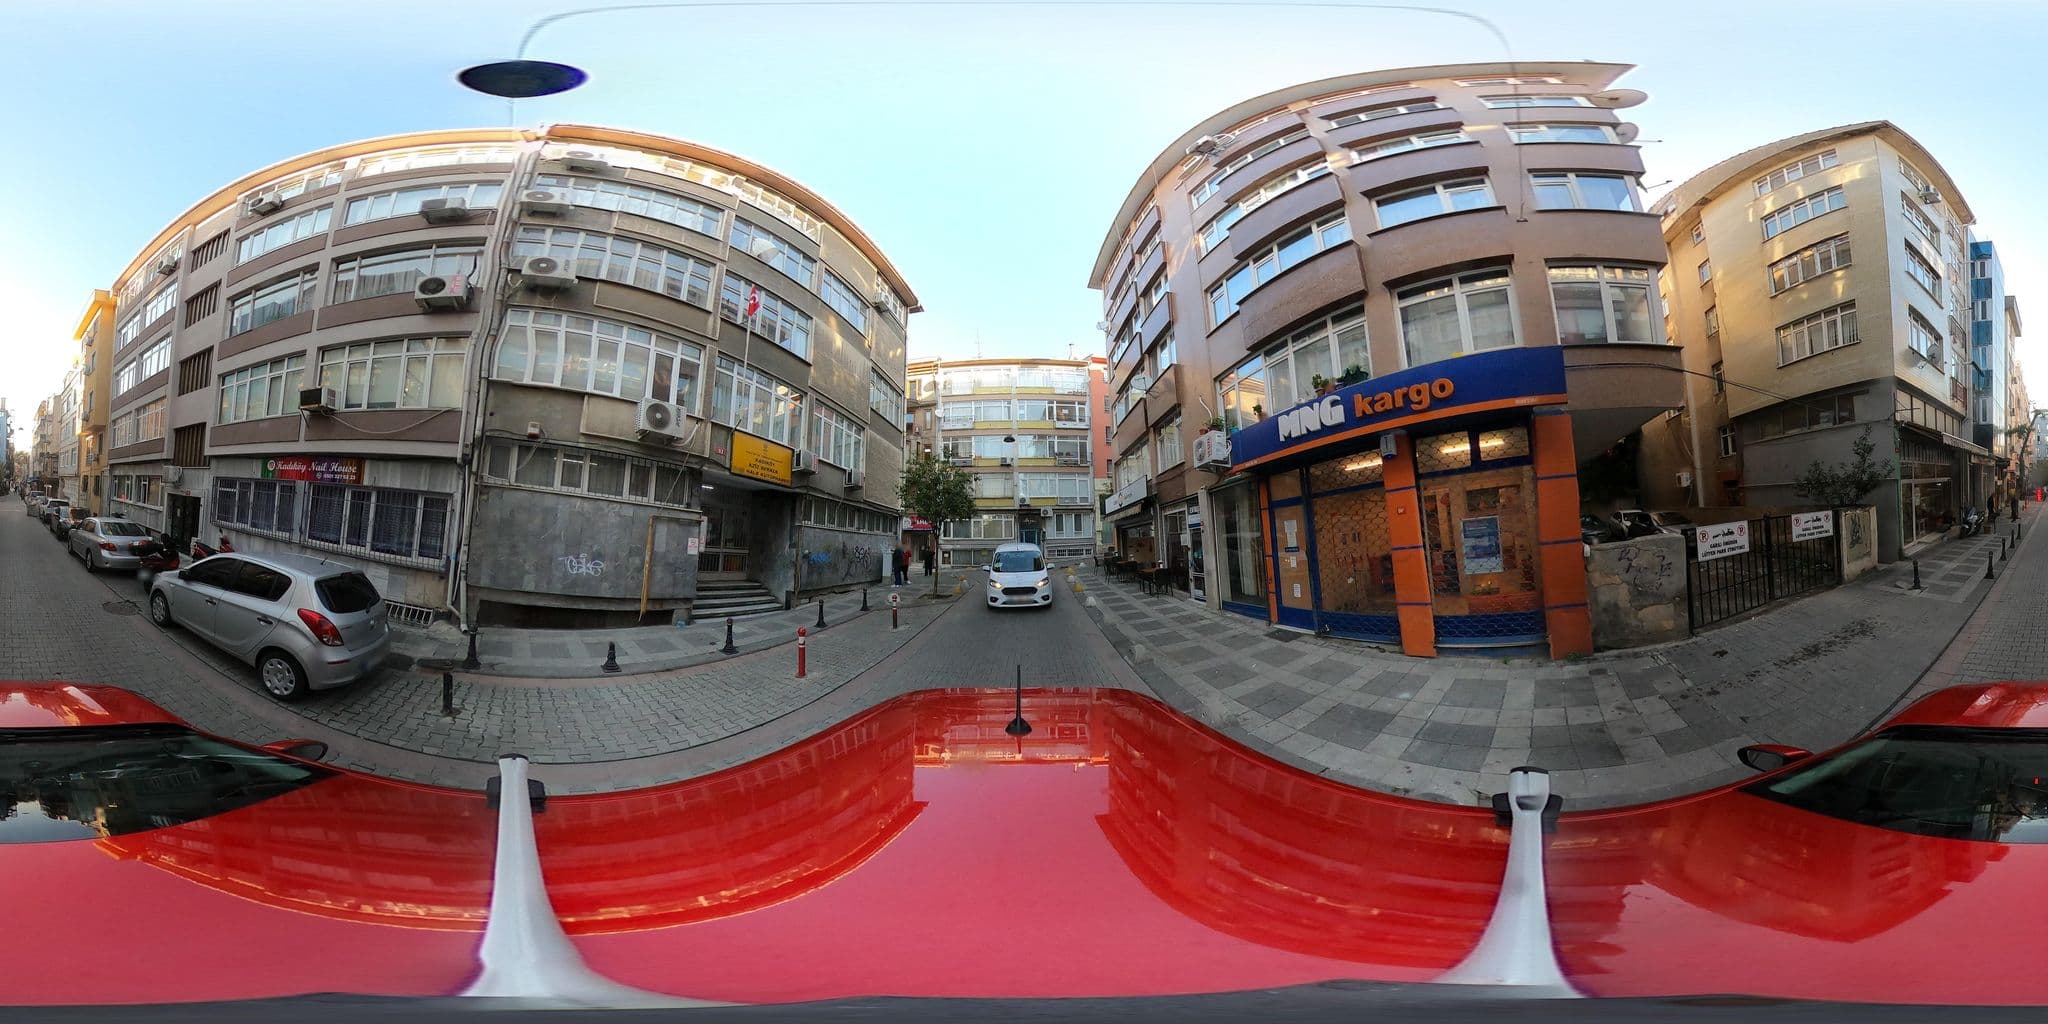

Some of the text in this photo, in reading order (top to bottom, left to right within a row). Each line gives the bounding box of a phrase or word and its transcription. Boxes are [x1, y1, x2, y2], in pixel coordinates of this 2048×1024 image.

[1278, 378, 1455, 441] MNG kargo
[276, 460, 357, 474] Kadıköy Nail House
